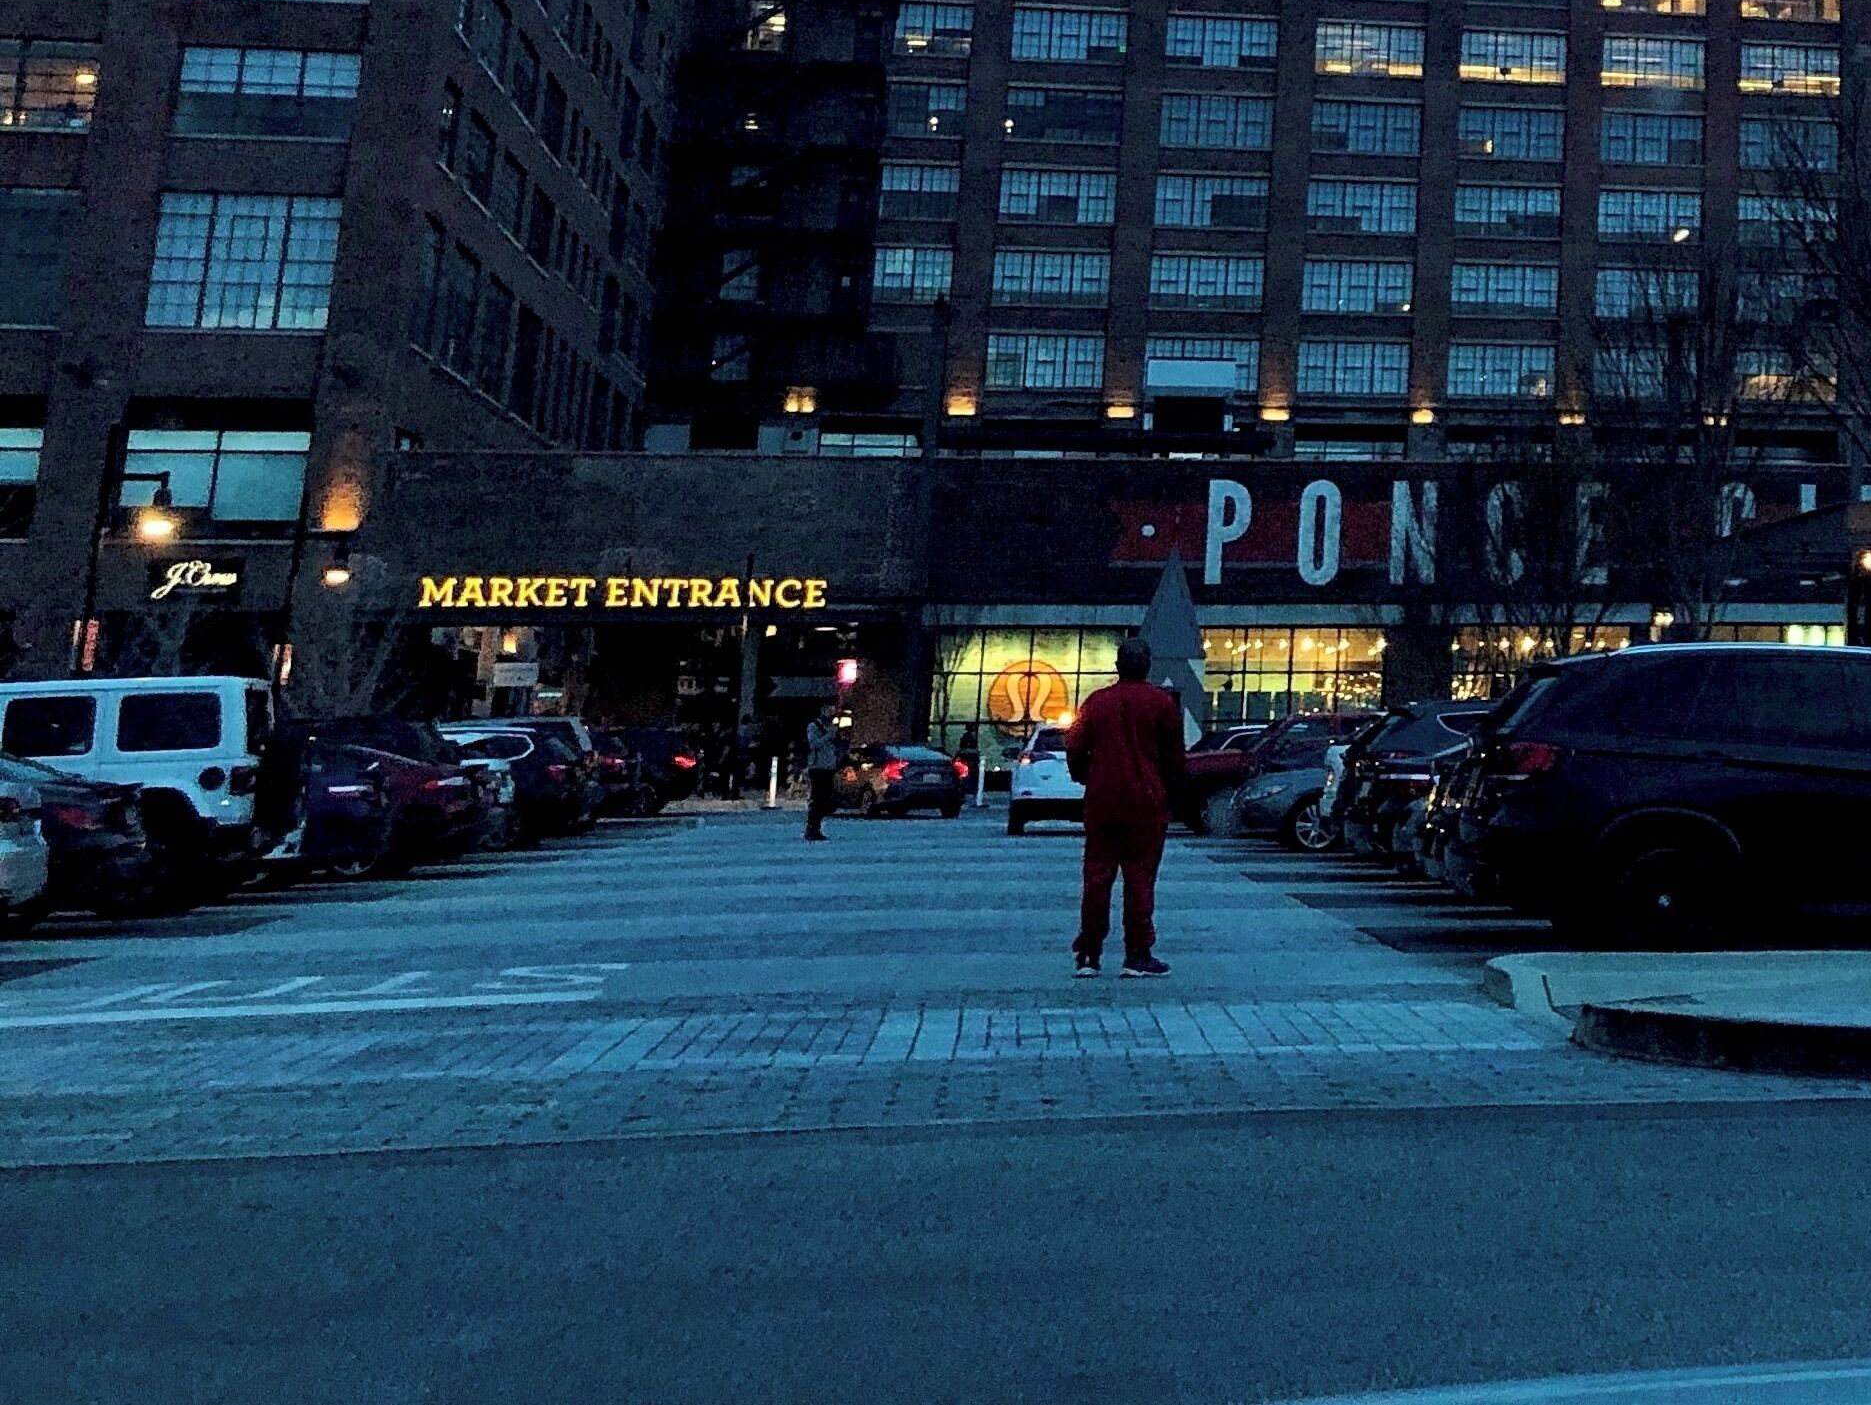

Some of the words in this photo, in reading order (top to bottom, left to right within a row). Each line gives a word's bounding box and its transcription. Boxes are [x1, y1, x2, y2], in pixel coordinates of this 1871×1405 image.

[1203, 478, 1612, 587] PONCE
[418, 576, 596, 608] MARKET
[604, 577, 828, 609] ENTRANCE
